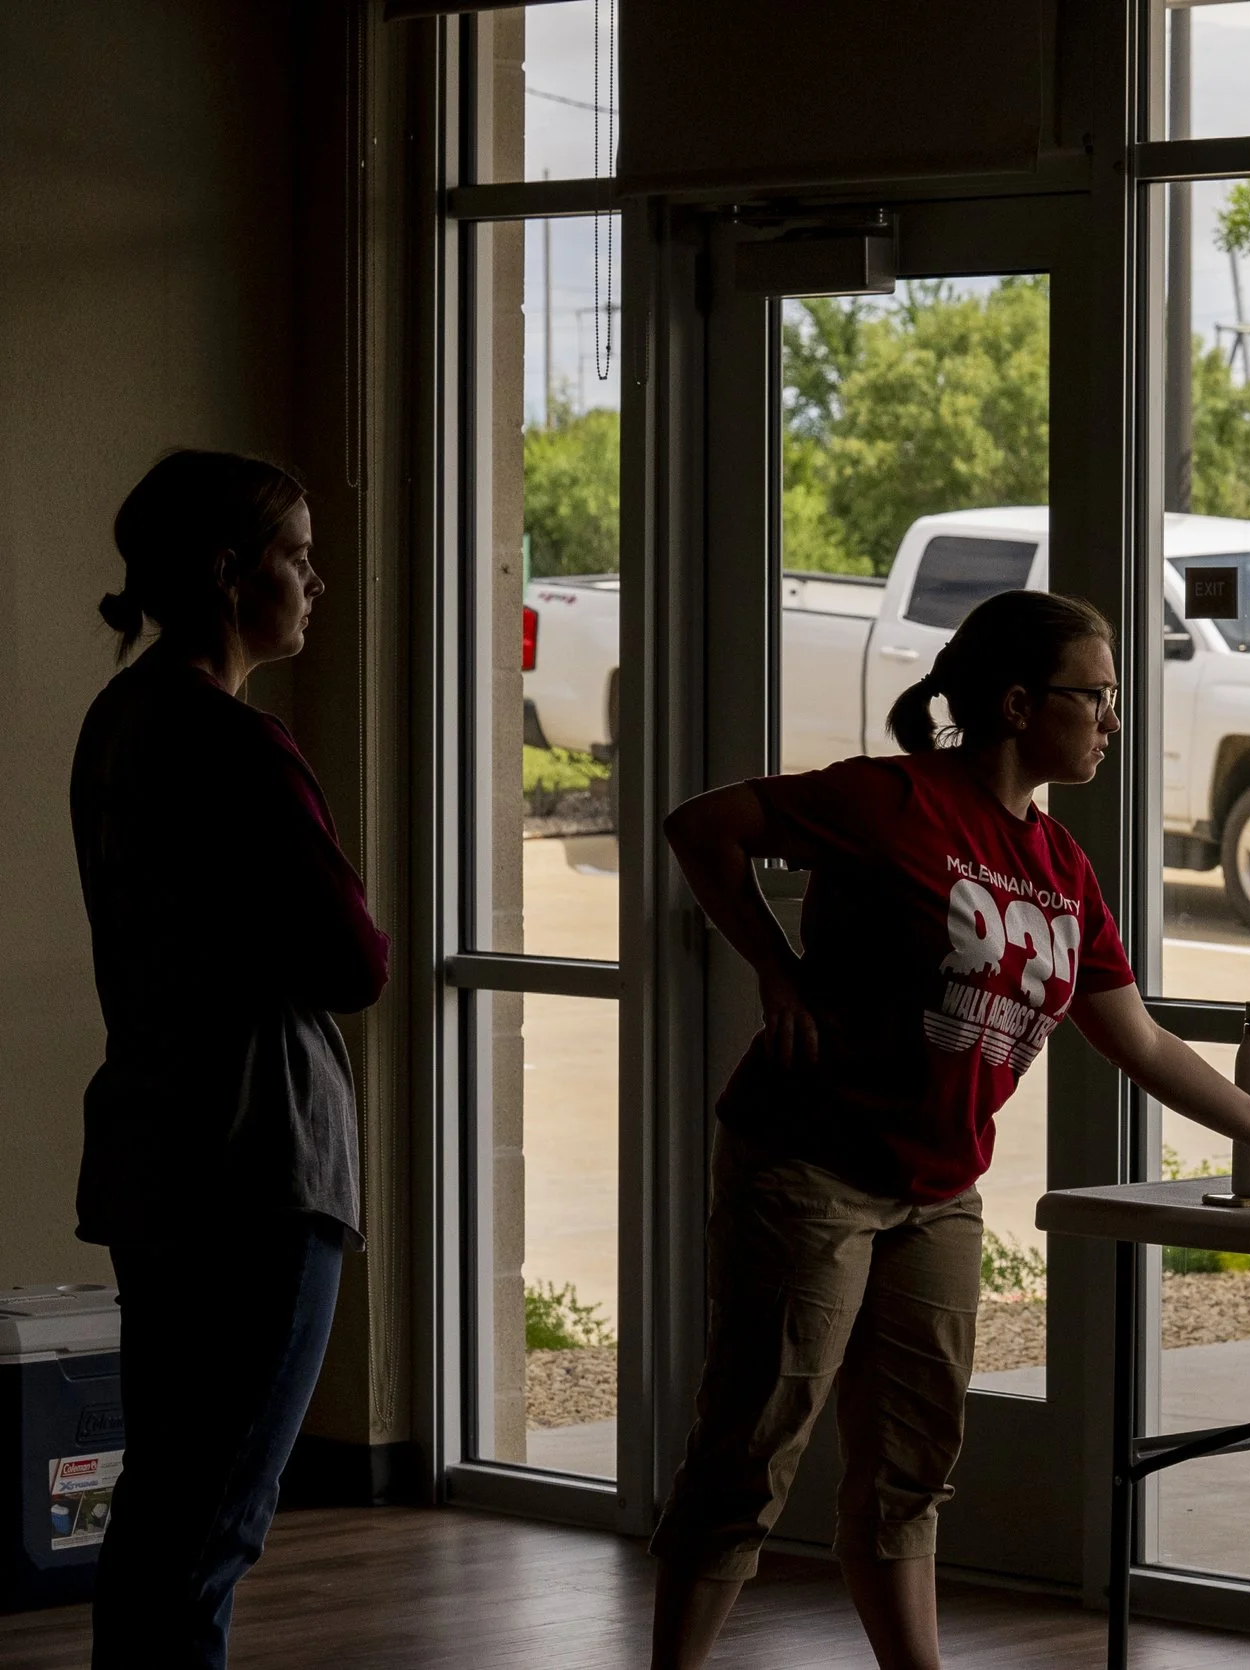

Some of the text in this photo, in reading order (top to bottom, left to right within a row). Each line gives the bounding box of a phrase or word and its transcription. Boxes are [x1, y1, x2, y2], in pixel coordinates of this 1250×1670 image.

[1195, 581, 1225, 597] EXIT
[946, 854, 1033, 898] McLENNAN
[941, 980, 993, 1026] WALK
[985, 993, 1035, 1039] ACROSS
